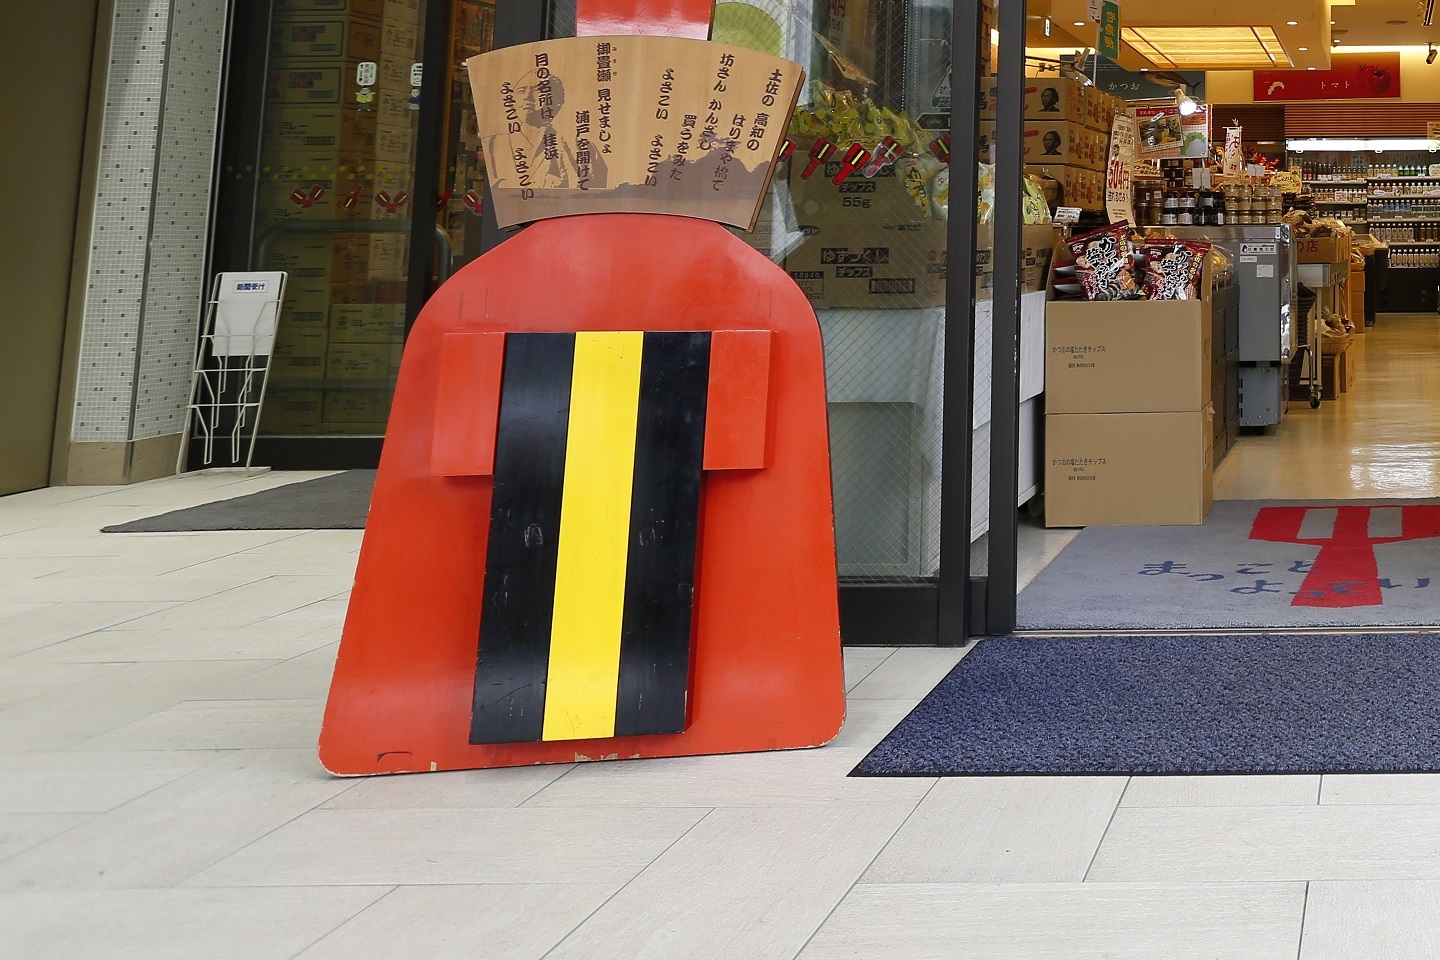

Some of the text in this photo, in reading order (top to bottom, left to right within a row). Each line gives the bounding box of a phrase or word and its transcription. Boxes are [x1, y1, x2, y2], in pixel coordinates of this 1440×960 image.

[534, 52, 559, 160] 月の名所は 桂浜
[699, 52, 734, 151] 坊さん かんざし
[746, 68, 783, 152] 土佐の 高知の
[1108, 82, 1140, 90] かつお
[1322, 80, 1350, 90] トマト
[500, 82, 535, 201] よさこい よさこい
[576, 110, 591, 191] 浦戸を開けて
[598, 88, 612, 154] 見せましょ
[644, 67, 675, 187] よさこい よさこい
[841, 183, 875, 192] チップス
[842, 197, 871, 208] 55g
[1108, 160, 1130, 190] 504円
[838, 267, 872, 277] チップス
